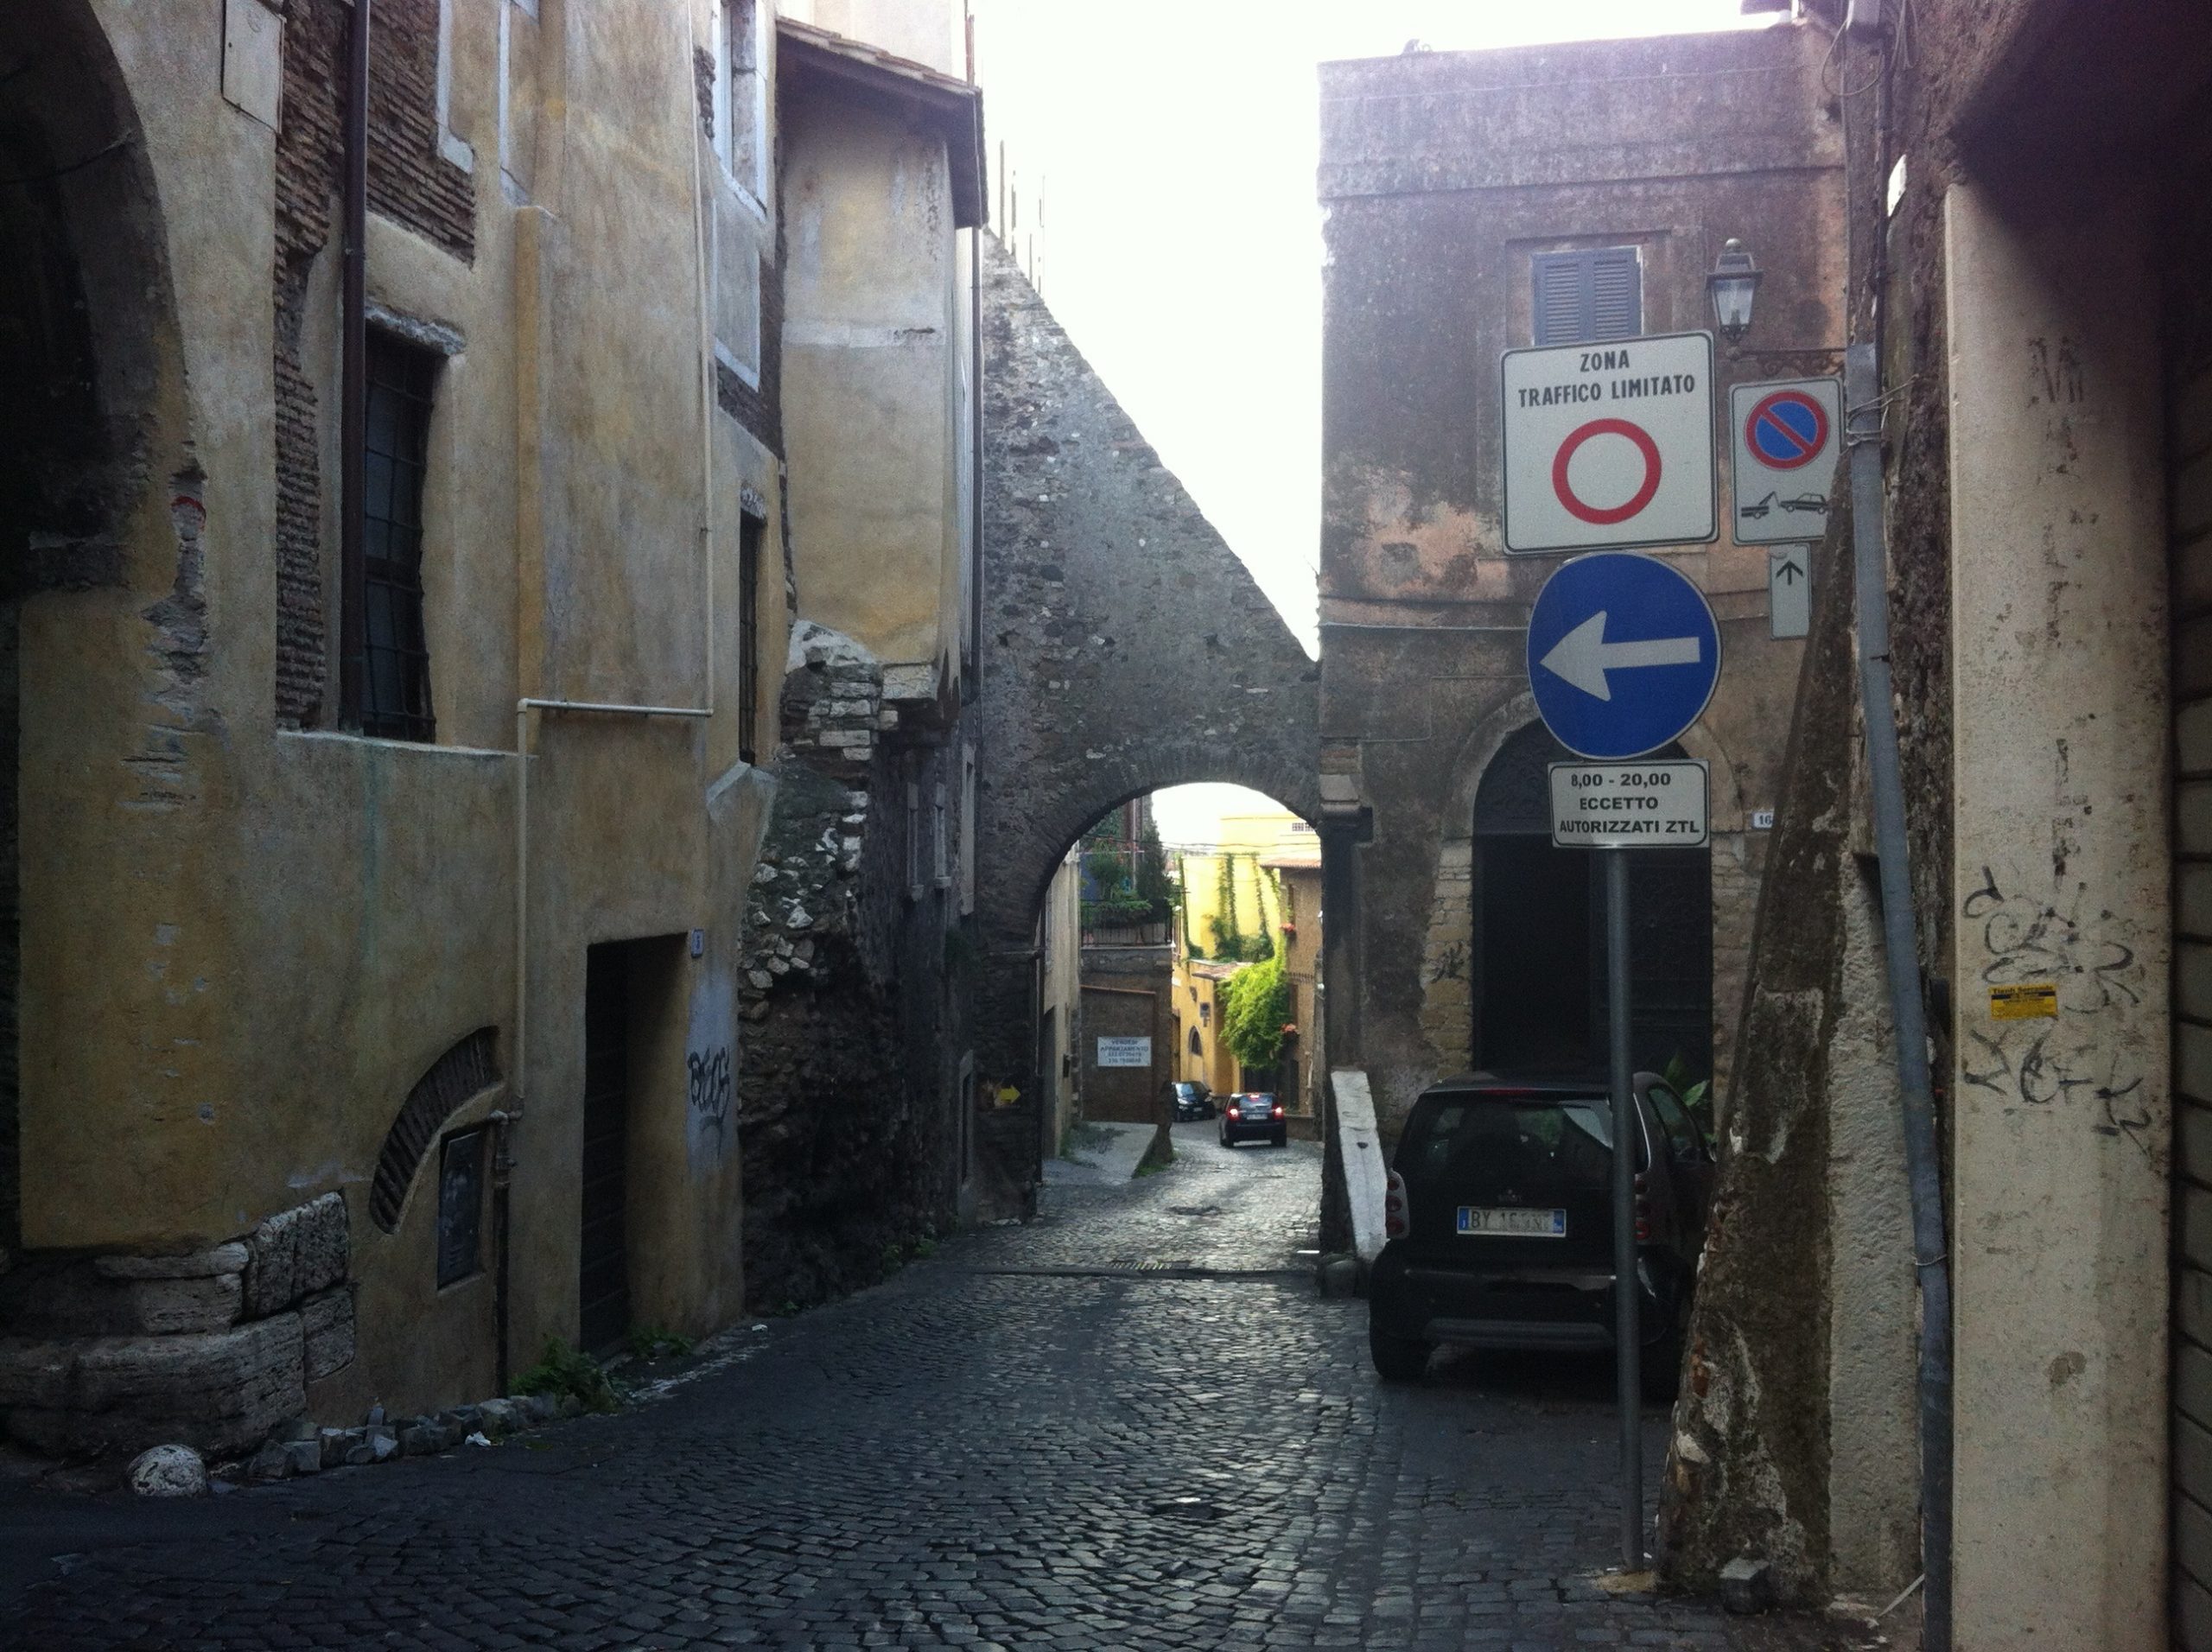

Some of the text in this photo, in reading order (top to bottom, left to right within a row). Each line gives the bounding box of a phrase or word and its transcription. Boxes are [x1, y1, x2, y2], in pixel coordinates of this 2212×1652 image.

[1580, 349, 1630, 372] ZONA
[1518, 374, 1695, 408] TRAFFICO LIMITATO
[1570, 773, 1603, 790] 8,00
[1620, 772, 1671, 788] 20,00
[1580, 797, 1659, 810] ECCETTO
[1560, 820, 1700, 834] AUTORIZZATI ZTL
[1759, 814, 1771, 826] 16
